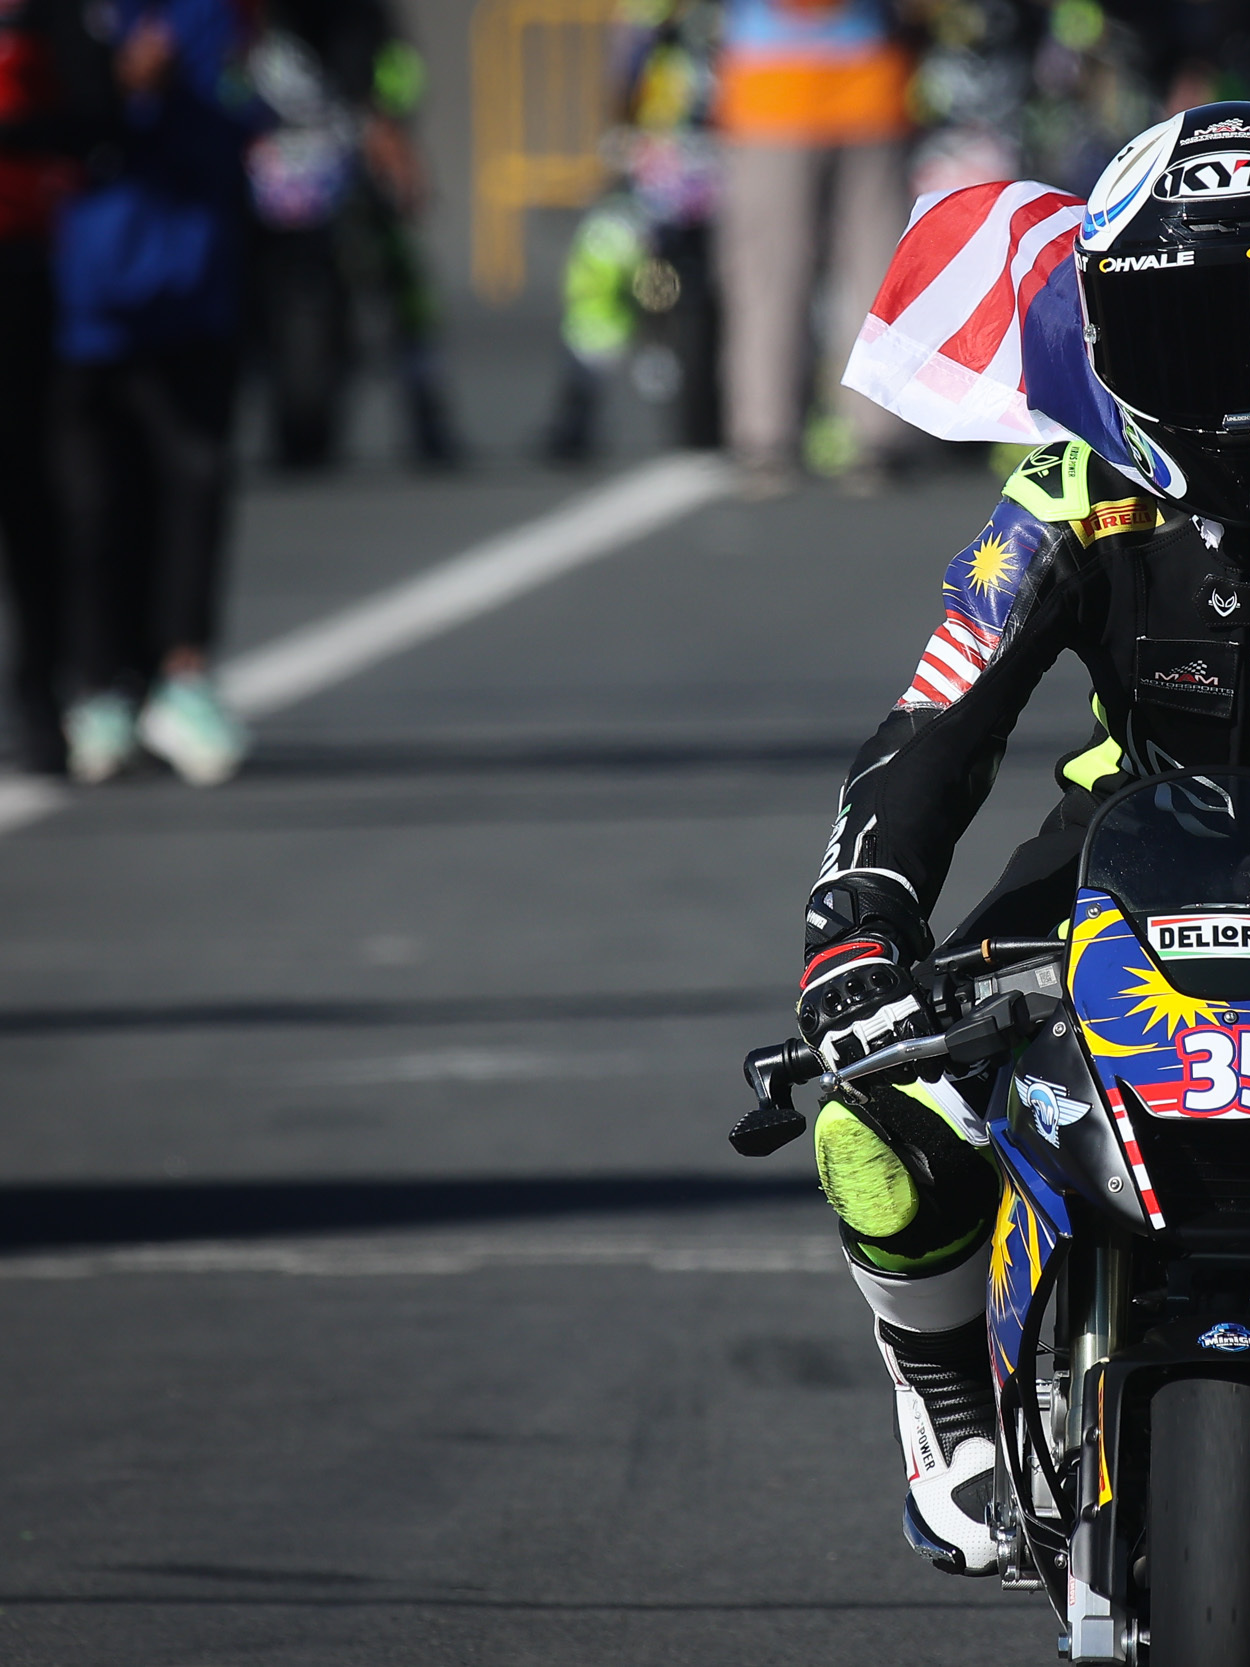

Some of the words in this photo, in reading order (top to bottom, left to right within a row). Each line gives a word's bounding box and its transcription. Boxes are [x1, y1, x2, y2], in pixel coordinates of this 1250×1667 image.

[1099, 250, 1195, 273] OHVALE
[1081, 503, 1153, 537] PIRELLI
[1140, 678, 1234, 694] MOTORSPORTS
[1155, 672, 1219, 686] MAM
